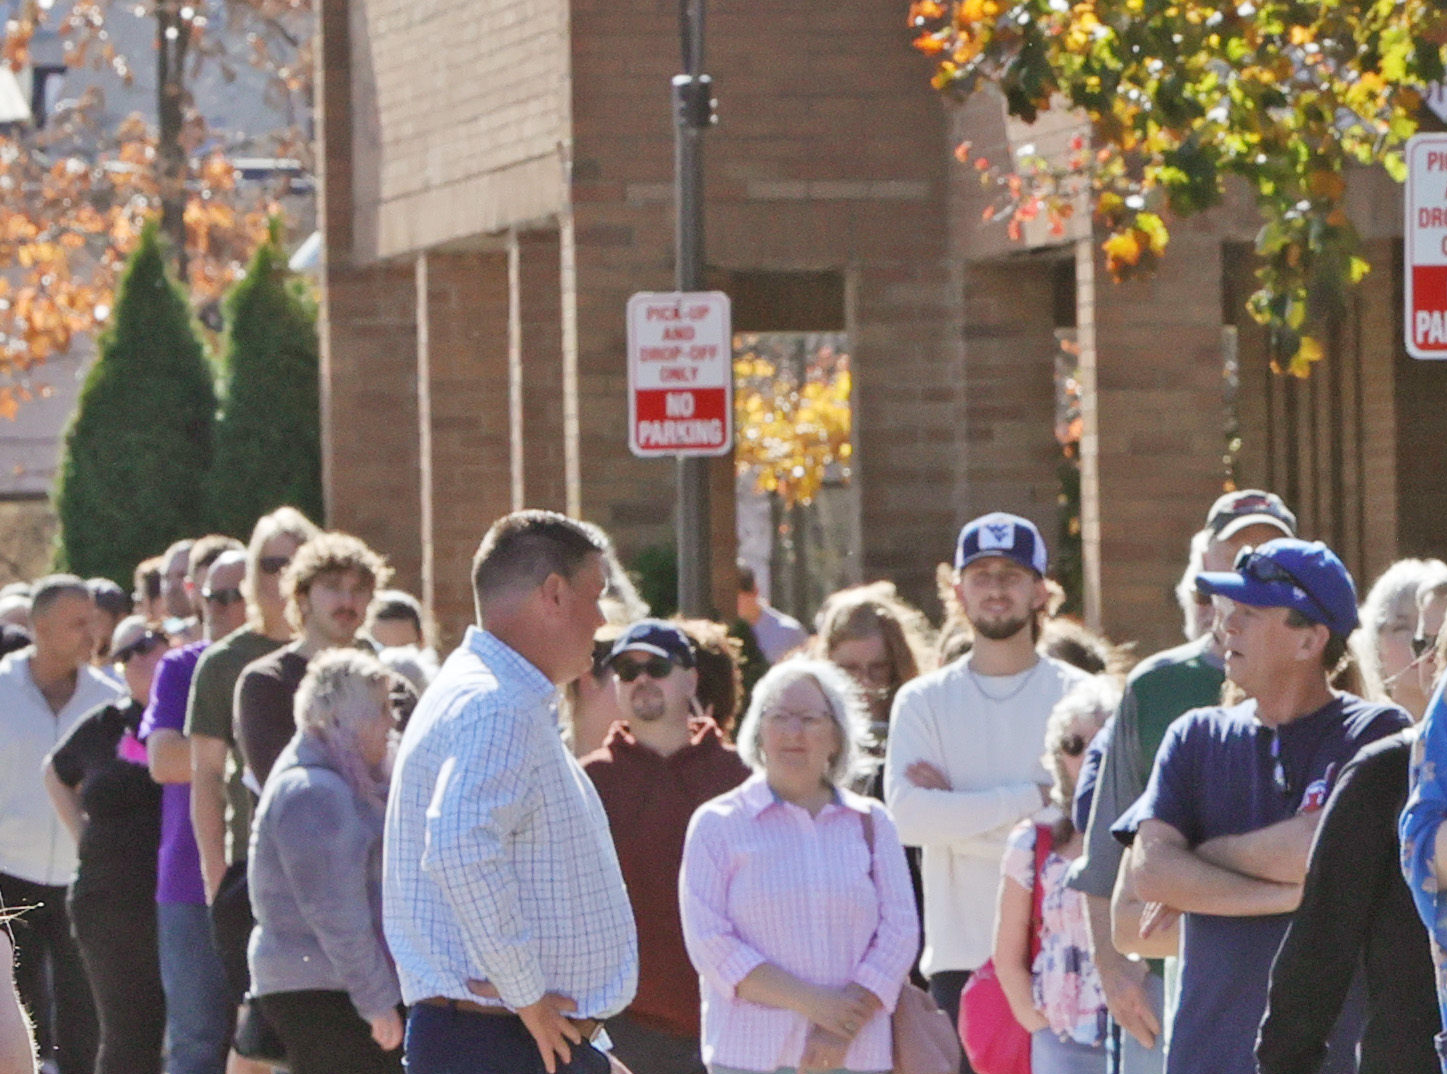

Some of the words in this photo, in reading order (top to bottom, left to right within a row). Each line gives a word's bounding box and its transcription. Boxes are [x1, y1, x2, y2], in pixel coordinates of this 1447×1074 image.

[646, 304, 711, 322] PICK-UP
[662, 326, 696, 341] AND
[640, 345, 718, 362] DROP-OFF
[660, 367, 699, 382] ONLY
[665, 391, 695, 418] NO
[638, 418, 723, 446] PARKING
